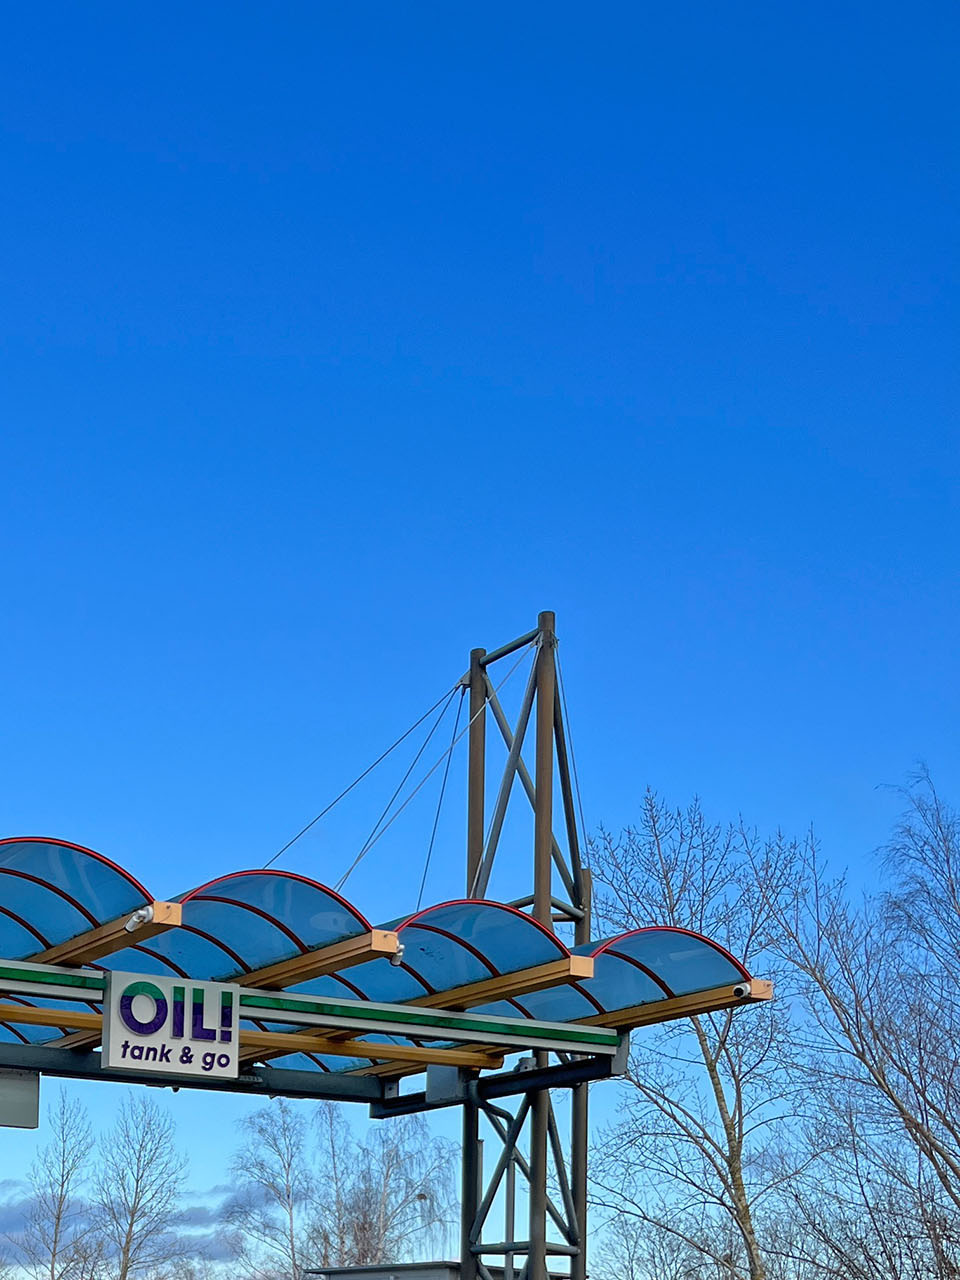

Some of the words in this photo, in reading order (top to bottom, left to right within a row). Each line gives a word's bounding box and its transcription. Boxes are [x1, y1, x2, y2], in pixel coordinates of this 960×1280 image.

[119, 981, 233, 1043] OIL!
[121, 1040, 172, 1063] tank
[179, 1046, 194, 1064] &
[201, 1052, 230, 1071] go
